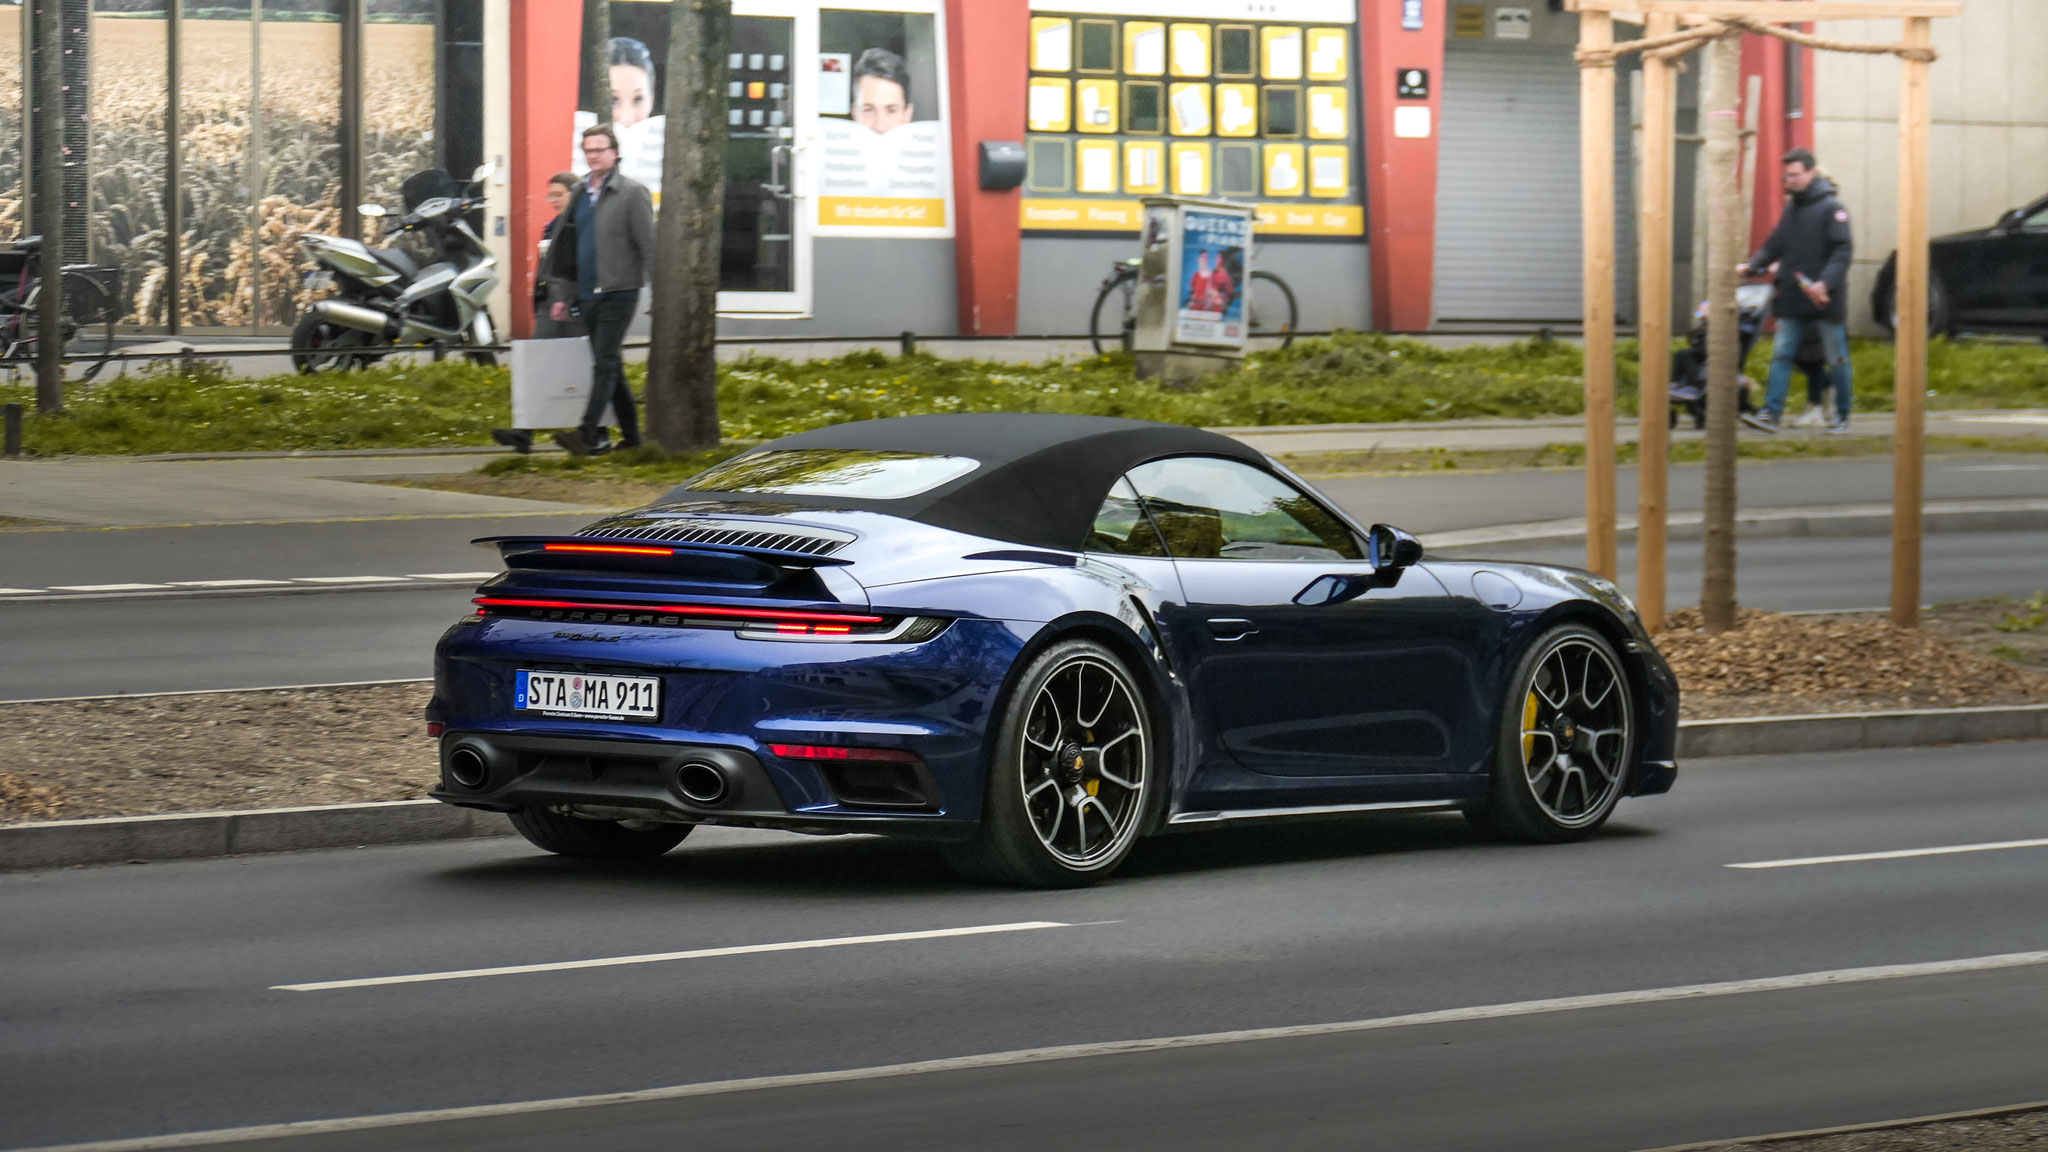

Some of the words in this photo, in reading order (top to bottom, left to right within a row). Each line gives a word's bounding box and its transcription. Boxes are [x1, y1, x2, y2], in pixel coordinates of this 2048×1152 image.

[530, 609, 680, 625] PORSCHE
[518, 694, 524, 702] D
[529, 676, 566, 706] STA
[584, 679, 609, 709] MA
[616, 681, 654, 711] 911
